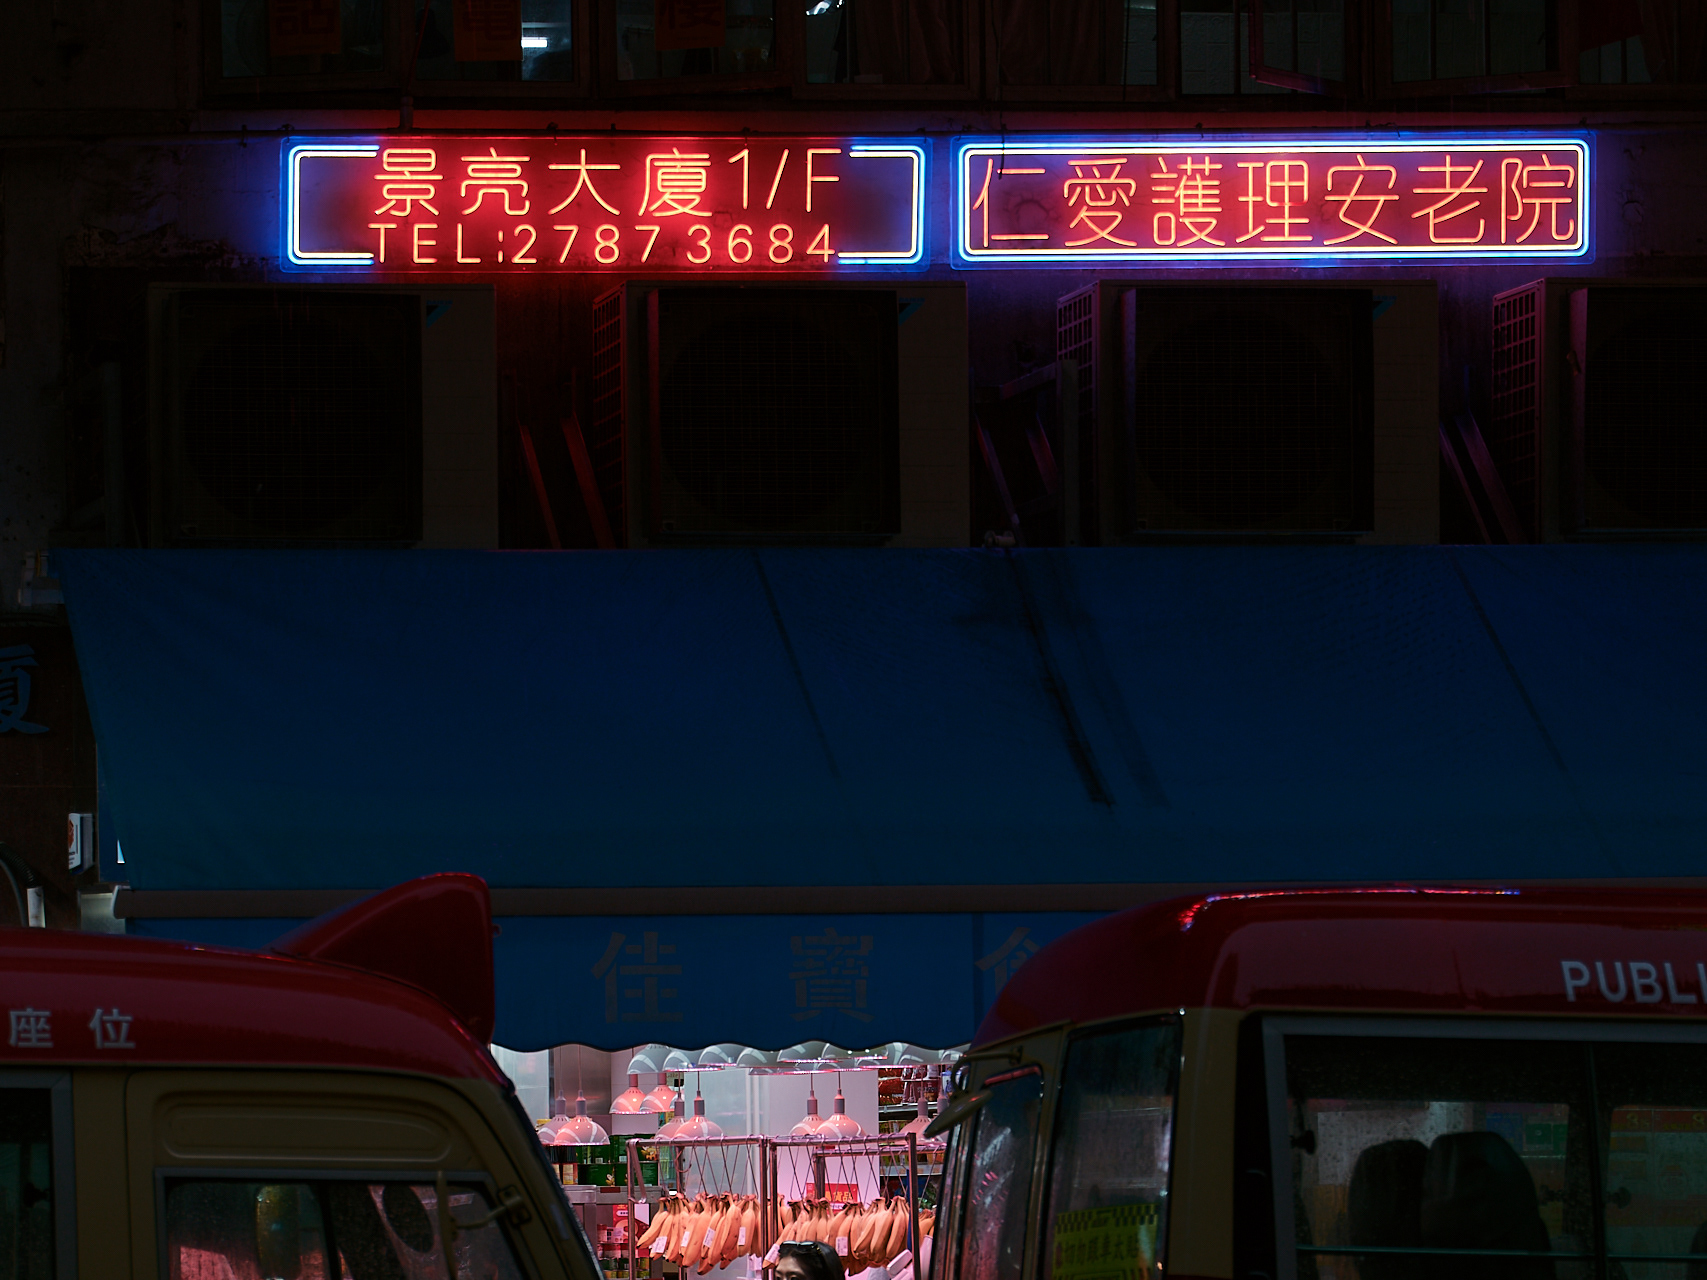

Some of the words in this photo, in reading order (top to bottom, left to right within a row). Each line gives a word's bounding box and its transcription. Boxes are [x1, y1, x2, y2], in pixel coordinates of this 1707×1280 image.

[375, 147, 713, 218] 景亮大廈
[729, 148, 842, 212] 1/F
[972, 154, 1576, 248] 仁愛護理安老院
